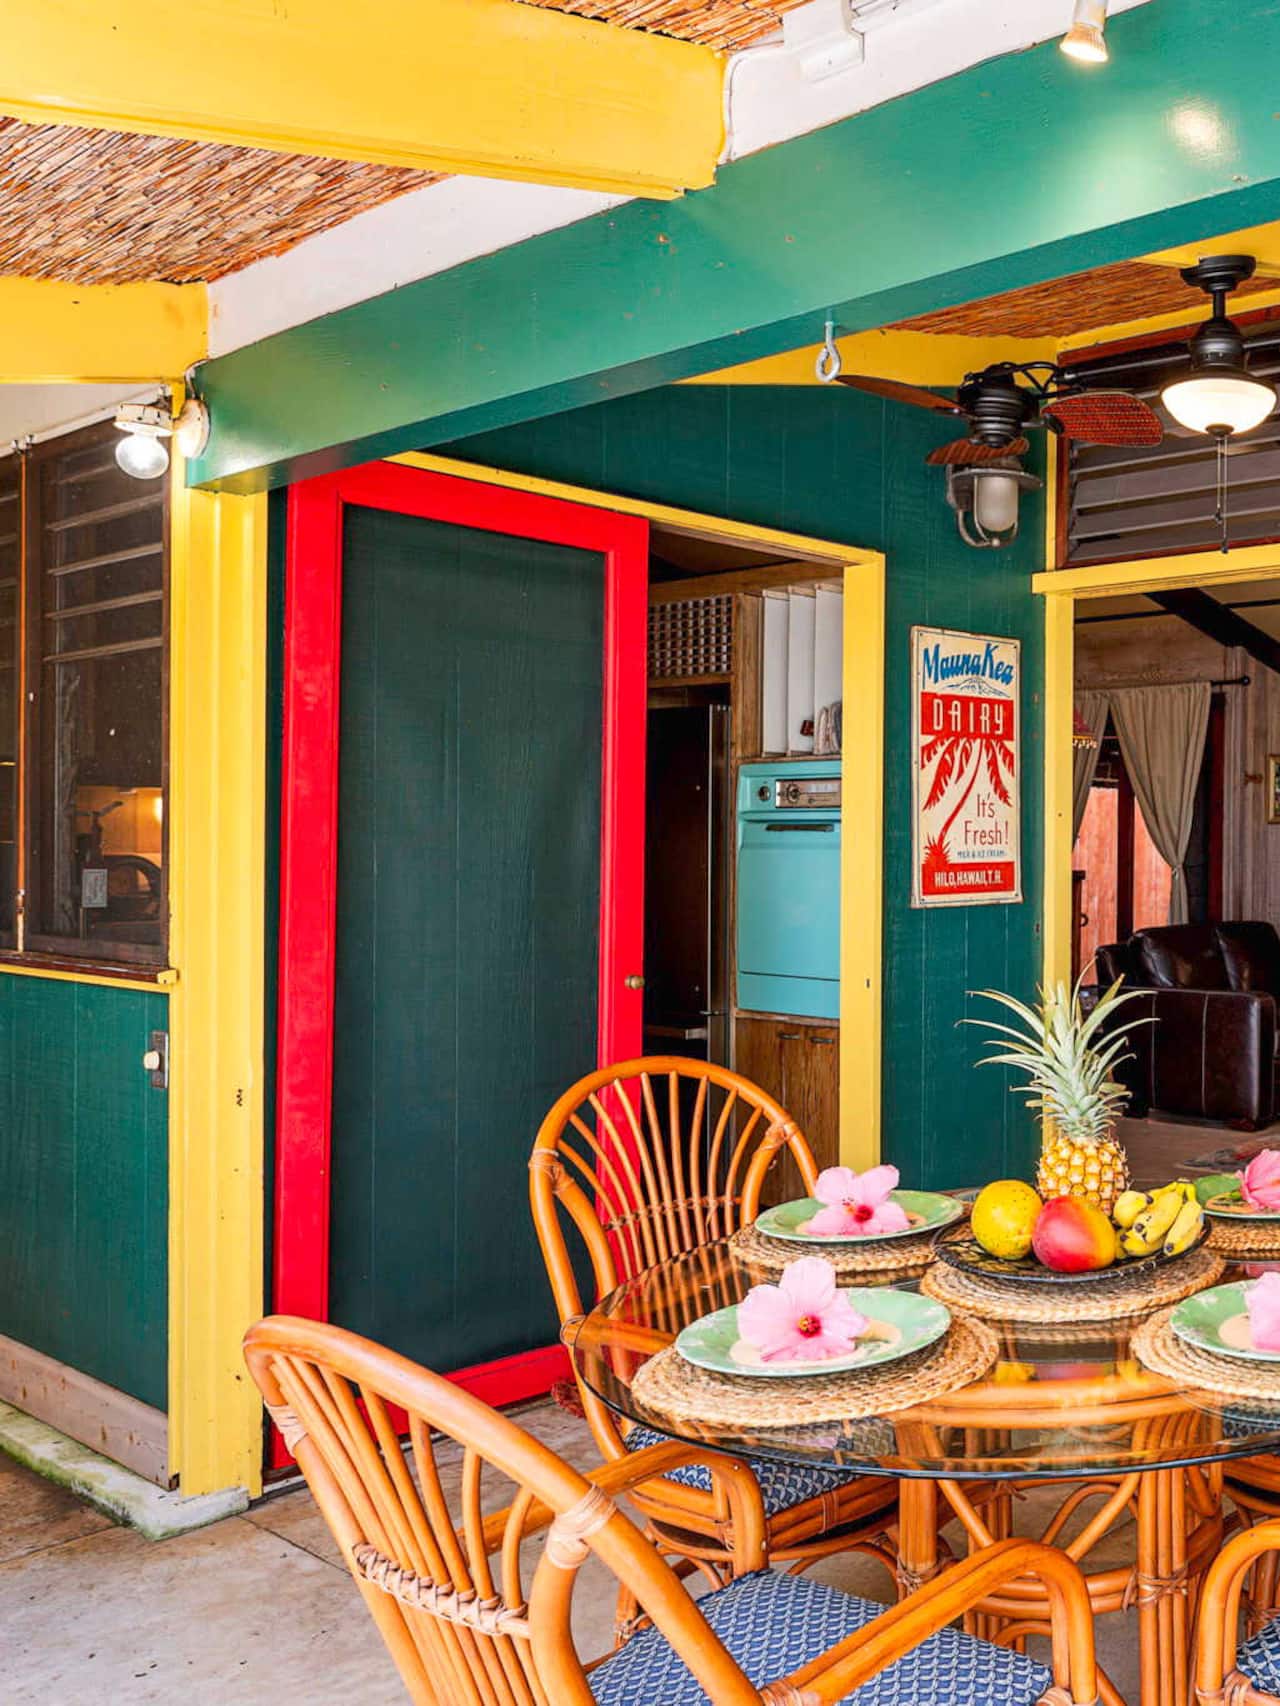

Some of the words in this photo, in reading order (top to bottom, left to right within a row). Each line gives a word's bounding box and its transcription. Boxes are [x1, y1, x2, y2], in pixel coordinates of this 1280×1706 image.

[933, 698, 1004, 735] DAIRY
[977, 792, 995, 818] It's
[964, 820, 1008, 845] Fresh!
